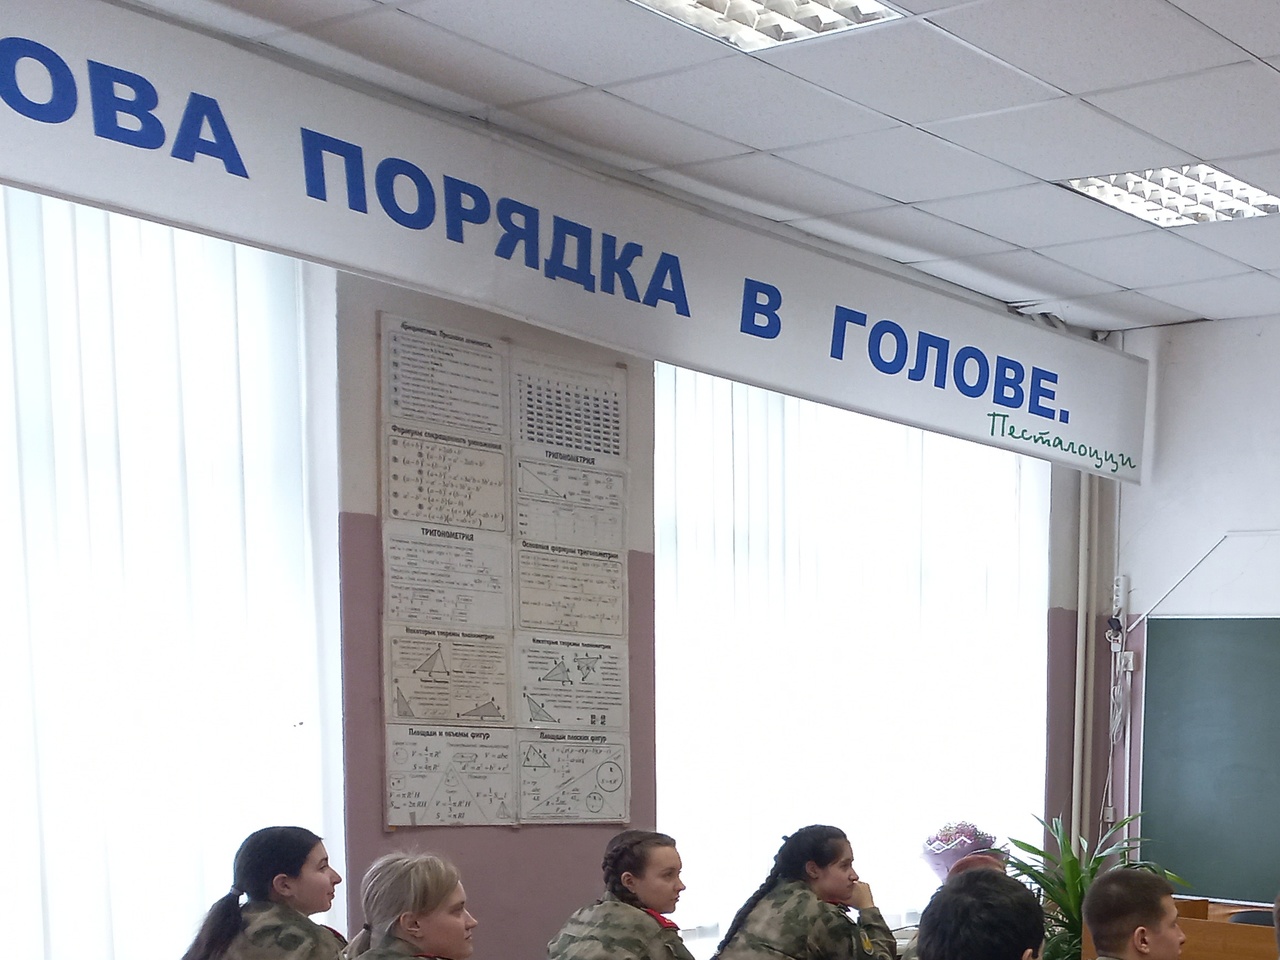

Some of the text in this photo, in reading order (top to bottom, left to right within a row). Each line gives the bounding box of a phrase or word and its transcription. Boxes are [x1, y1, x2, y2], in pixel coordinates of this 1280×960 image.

[0, 37, 1070, 424] ОВА ПОРЯДКА В ГОЛОВЕ.
[987, 412, 1136, 472] Песталоцци
[545, 450, 595, 465] ТРИГОНОМЕТРИЯ
[421, 528, 474, 541] ТРИГОНОМЕТРИЯ
[470, 732, 490, 740] фигур
